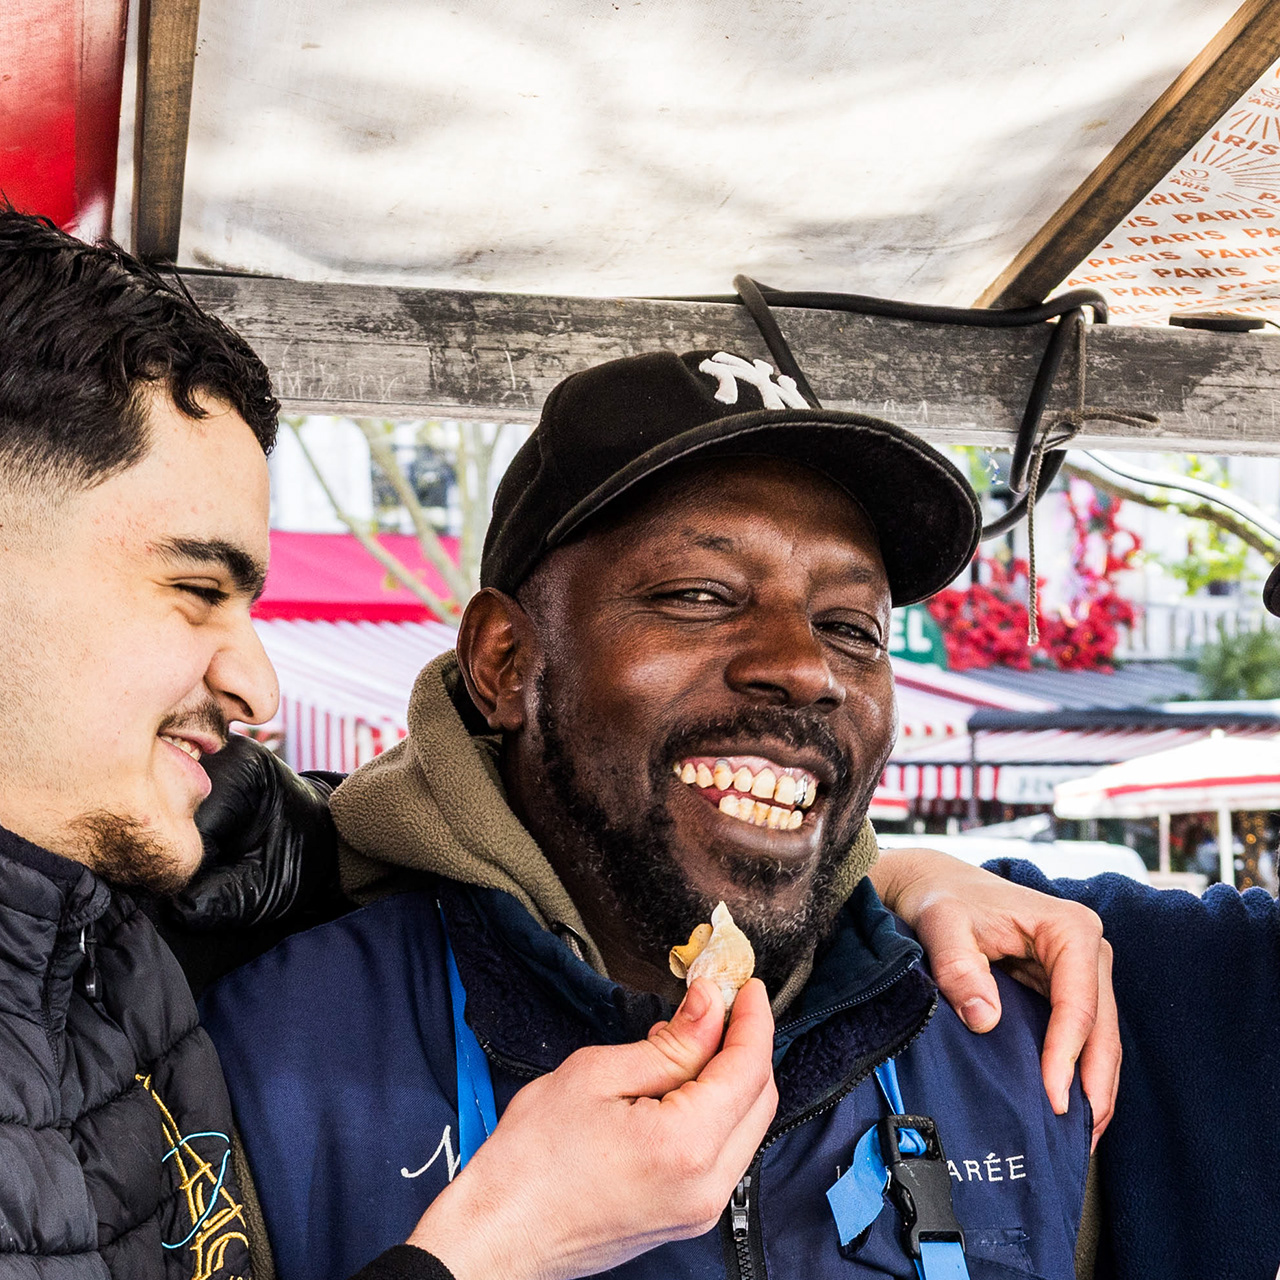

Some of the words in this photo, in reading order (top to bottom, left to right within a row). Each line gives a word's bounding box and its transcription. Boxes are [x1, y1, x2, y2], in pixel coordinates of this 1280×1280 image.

[1172, 207, 1276, 224] PARIS
[1127, 230, 1227, 246] PARIS
[1087, 251, 1183, 268] PARIS
[1067, 271, 1138, 287] ARIS
[1152, 267, 1248, 279] PARIS
[1108, 286, 1203, 297] PARIS
[946, 1152, 1028, 1183] ARÉE
